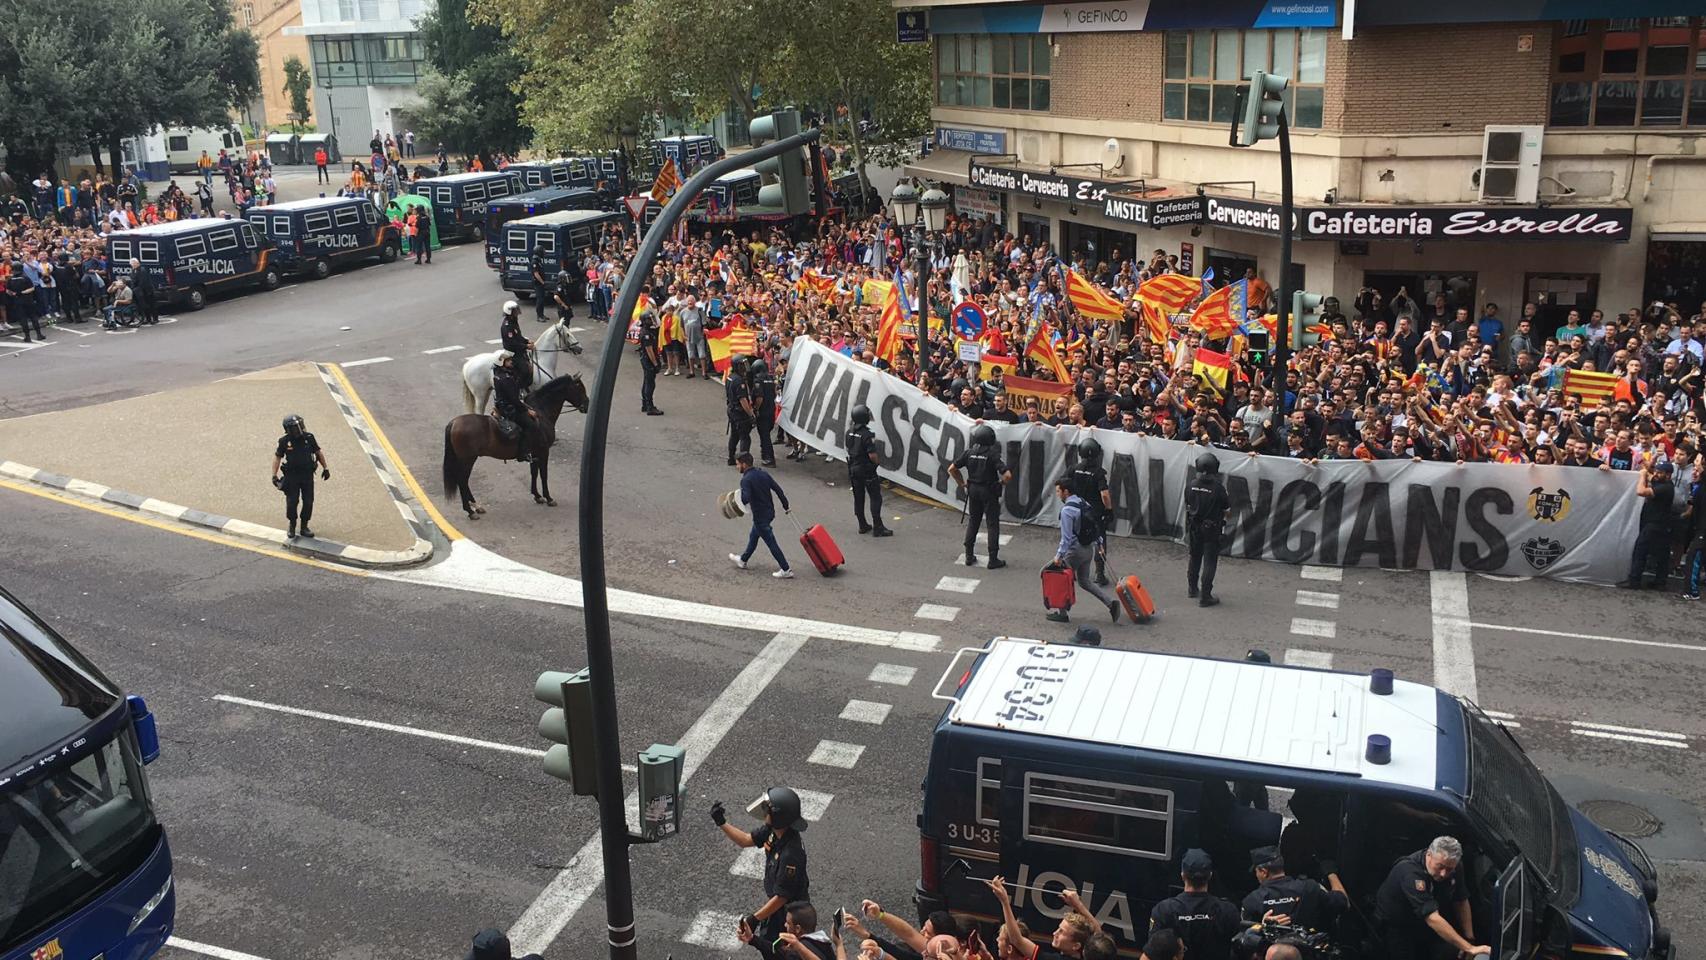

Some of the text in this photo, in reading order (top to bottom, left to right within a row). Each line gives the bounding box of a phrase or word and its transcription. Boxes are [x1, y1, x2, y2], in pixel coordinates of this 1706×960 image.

[939, 129, 951, 147] JC
[979, 167, 1016, 189] Cafetería
[1022, 173, 1069, 198] Cervecería
[1105, 199, 1148, 223] AMSTEL
[1156, 201, 1200, 214] Cafetería
[1207, 199, 1280, 231] Cervecería
[1152, 211, 1203, 225] Cervecería
[1307, 211, 1625, 235] Cafetería Estrella
[317, 233, 359, 248] POLICIA
[188, 258, 236, 275] POLICIA
[505, 255, 530, 264] POLICIA
[873, 394, 1045, 521] SERU
[1066, 442, 1515, 573] ALNCIANS
[948, 823, 959, 839] 3
[1178, 914, 1210, 922] POLICIA
